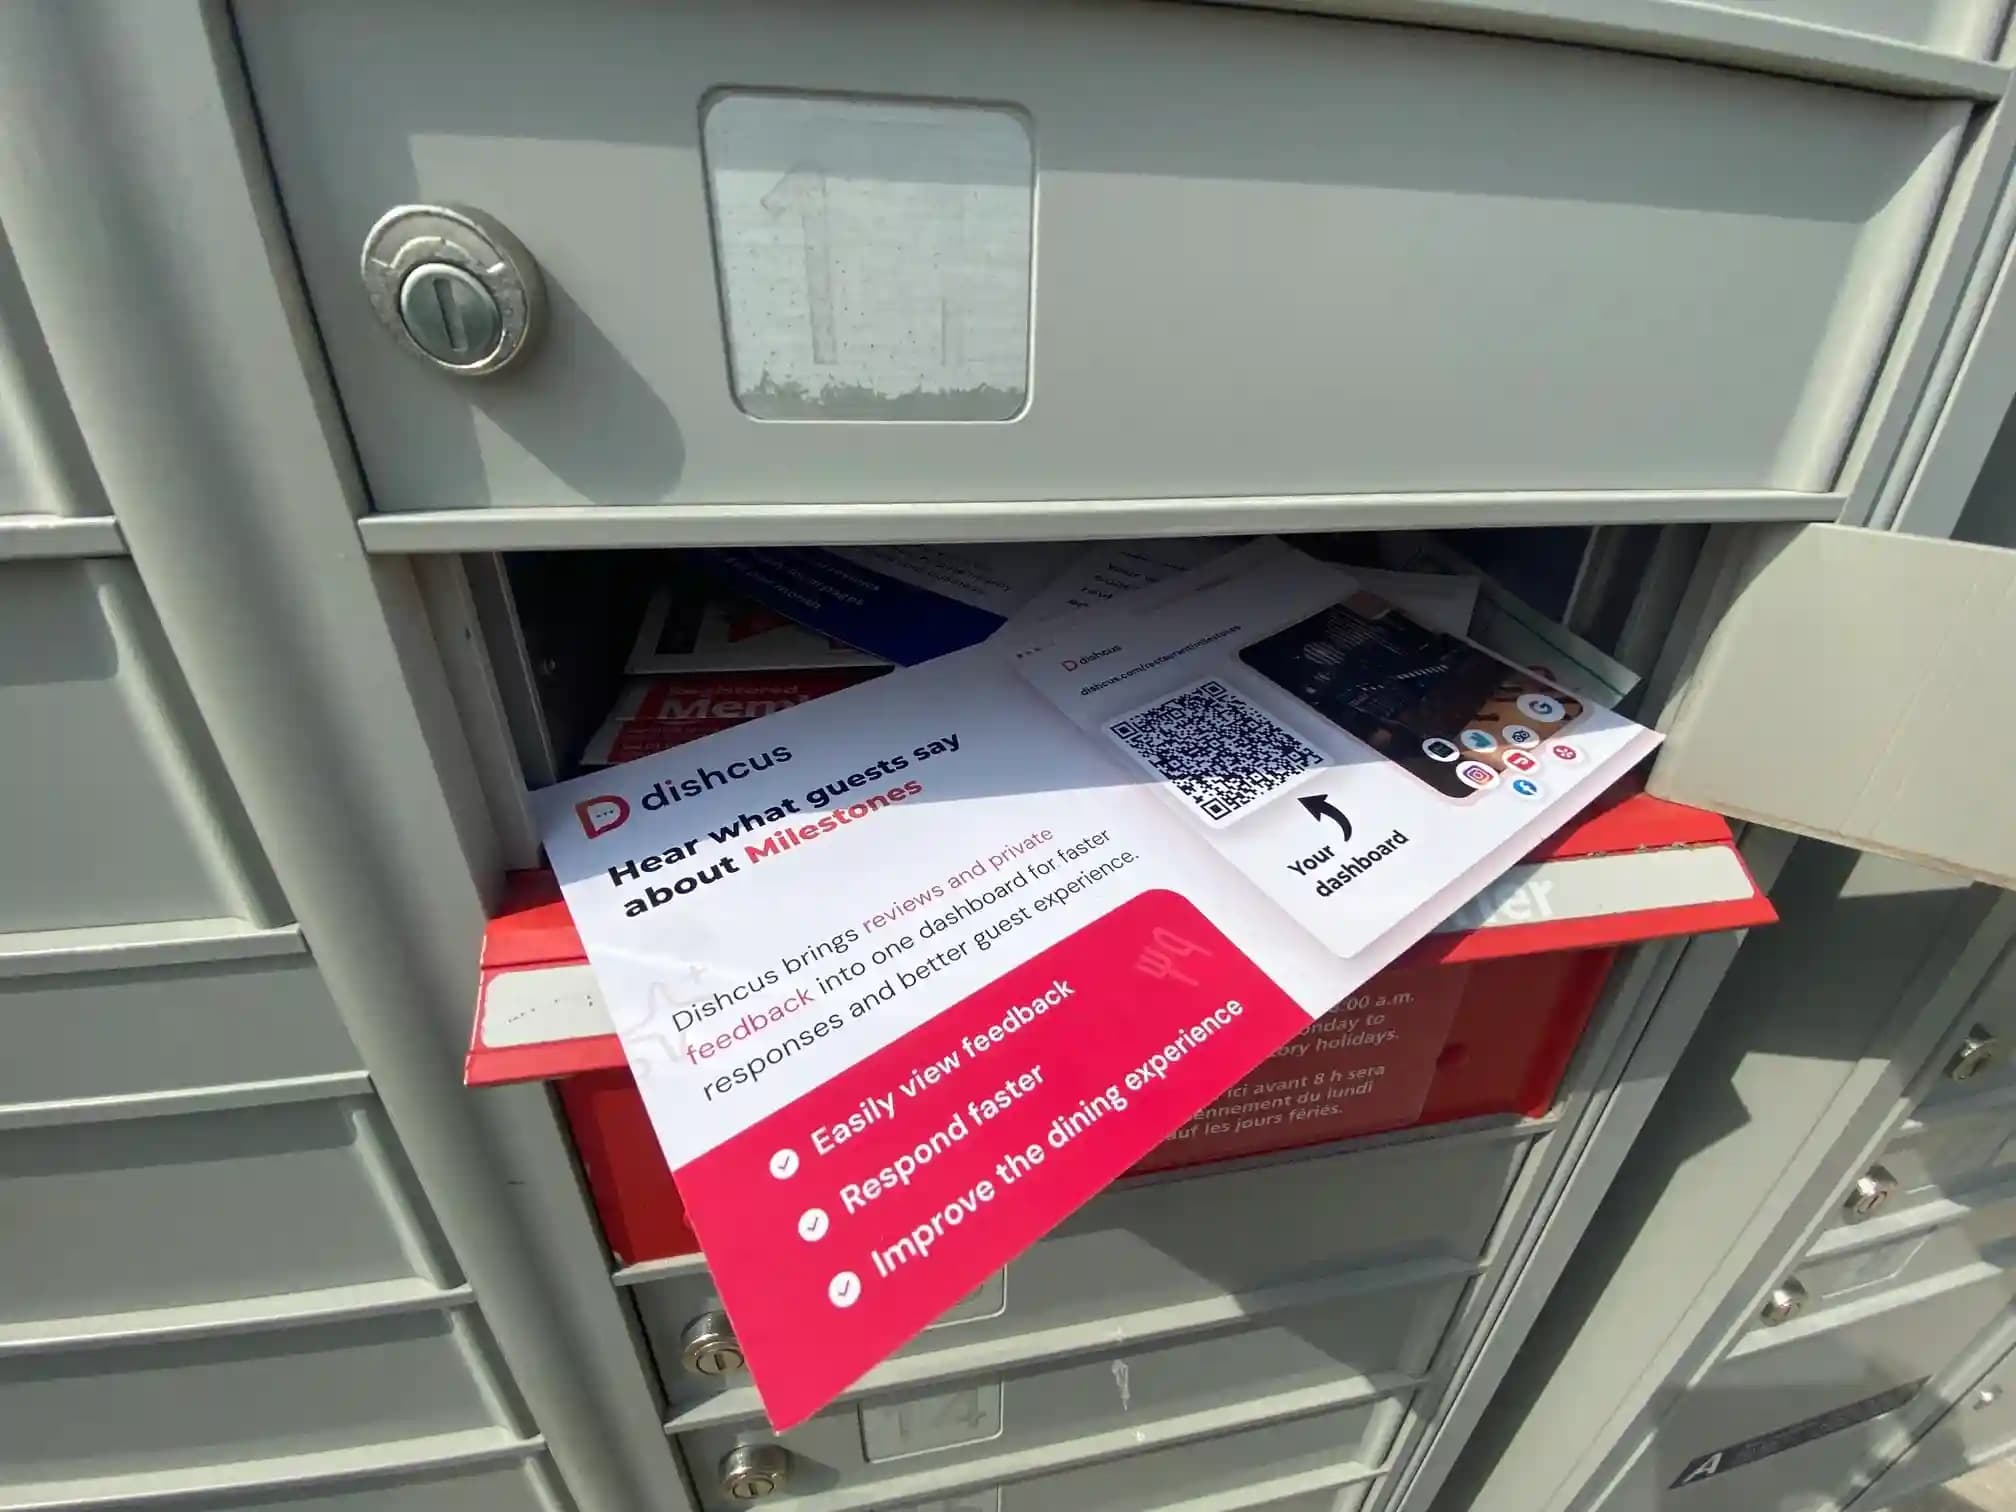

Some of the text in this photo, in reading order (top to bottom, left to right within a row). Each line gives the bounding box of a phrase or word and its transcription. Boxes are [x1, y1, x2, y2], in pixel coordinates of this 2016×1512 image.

[1079, 644, 1123, 665] dishcus
[656, 695, 809, 720] Mem
[641, 744, 793, 811] dishcus
[608, 732, 961, 887] Hear what guests say
[624, 779, 923, 918] about Milestones
[1288, 844, 1335, 876] Your
[1316, 829, 1410, 897] dashboard
[672, 829, 1054, 1032] Dishcus brings reviews and private
[686, 829, 1111, 1065] feedback into one dashboard for faster
[703, 850, 1139, 1102] responses and better guest experience.
[1375, 991, 1415, 1008] a.m.
[1270, 1028, 1399, 1057] ory holidays.
[1300, 1013, 1385, 1038] onday to
[810, 980, 1076, 1156] Easily view feedback
[1253, 1077, 1307, 1095] avant
[1314, 1072, 1325, 1085] 8
[1330, 1069, 1343, 1082] h
[1348, 1064, 1386, 1080] sera
[1193, 1080, 1374, 1120] ennement du lundi
[1204, 1121, 1231, 1136] les
[1234, 1112, 1282, 1134] jours
[840, 1064, 1045, 1214] Respond faster
[871, 1000, 1244, 1278] Improve the dining experience
[1683, 1452, 1724, 1484] A
